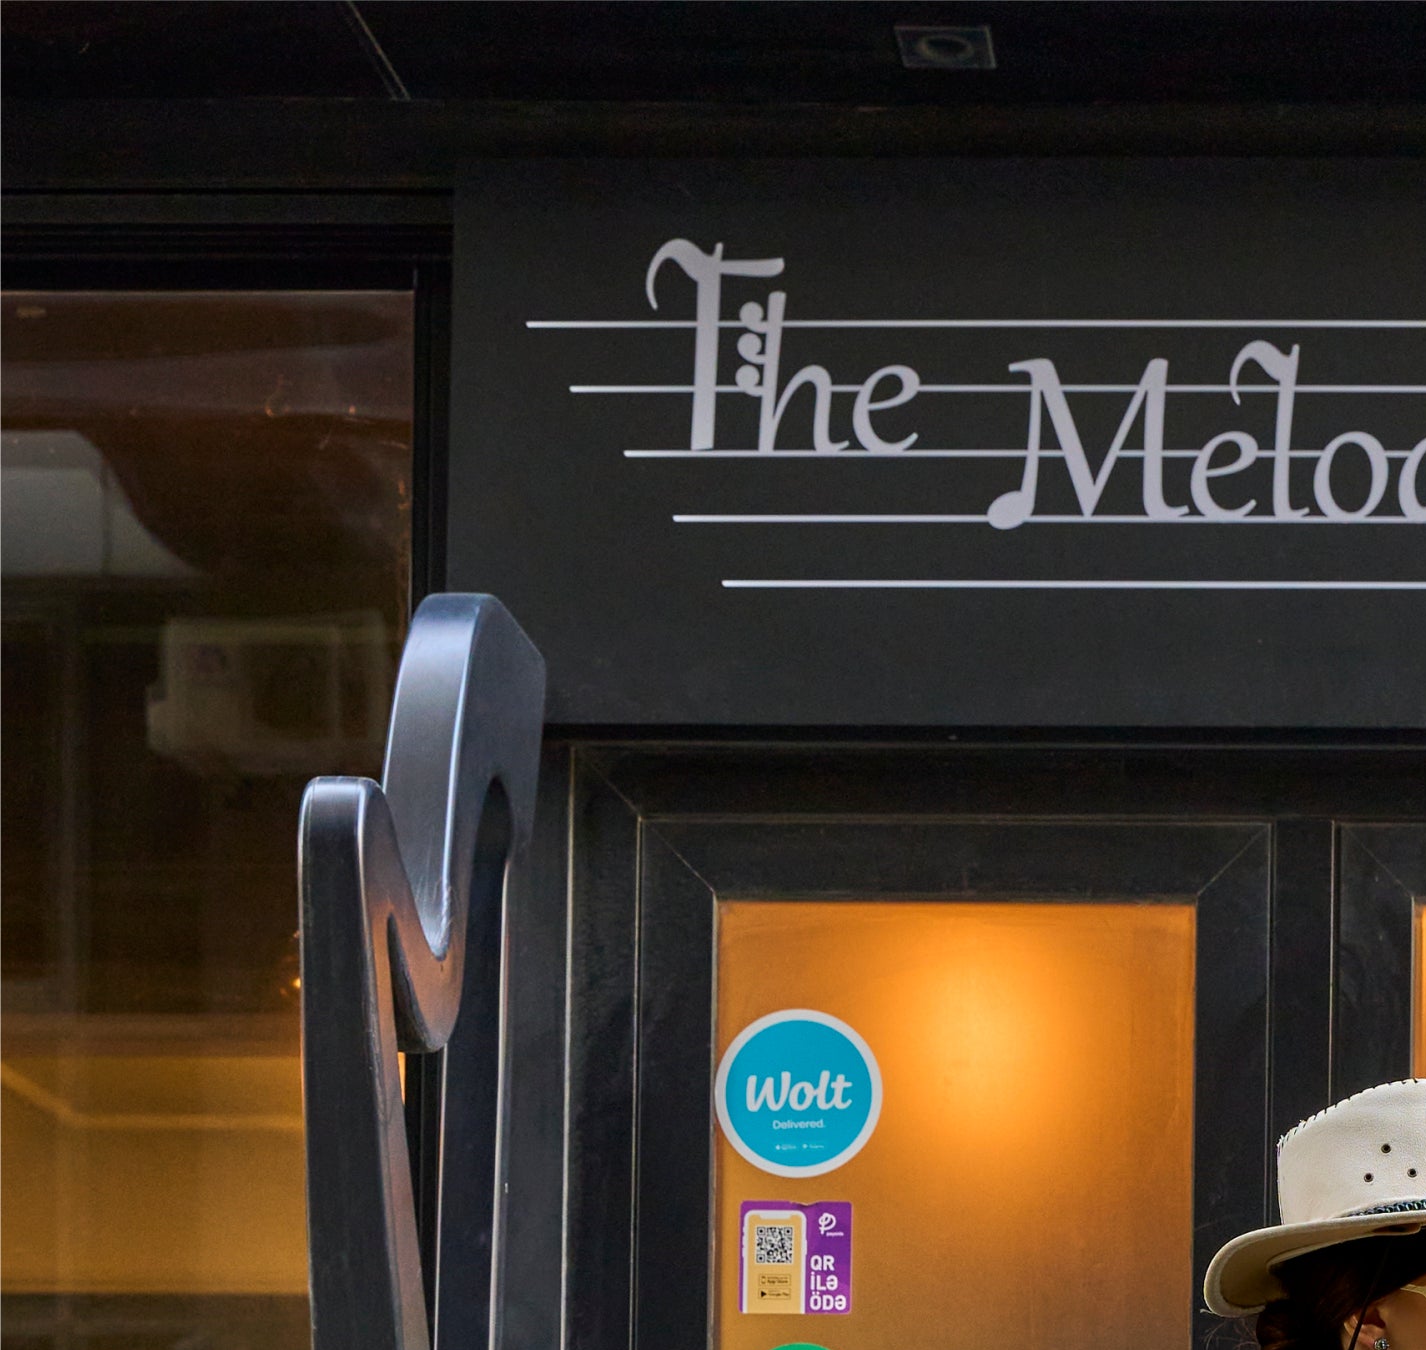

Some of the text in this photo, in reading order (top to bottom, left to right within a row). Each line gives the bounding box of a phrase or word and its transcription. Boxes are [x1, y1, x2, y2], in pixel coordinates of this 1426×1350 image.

[646, 238, 920, 453] The
[746, 1070, 852, 1112] Wolt
[810, 1255, 835, 1271] QR
[810, 1271, 838, 1291] İLƏ
[810, 1291, 846, 1310] ÖDƏ
